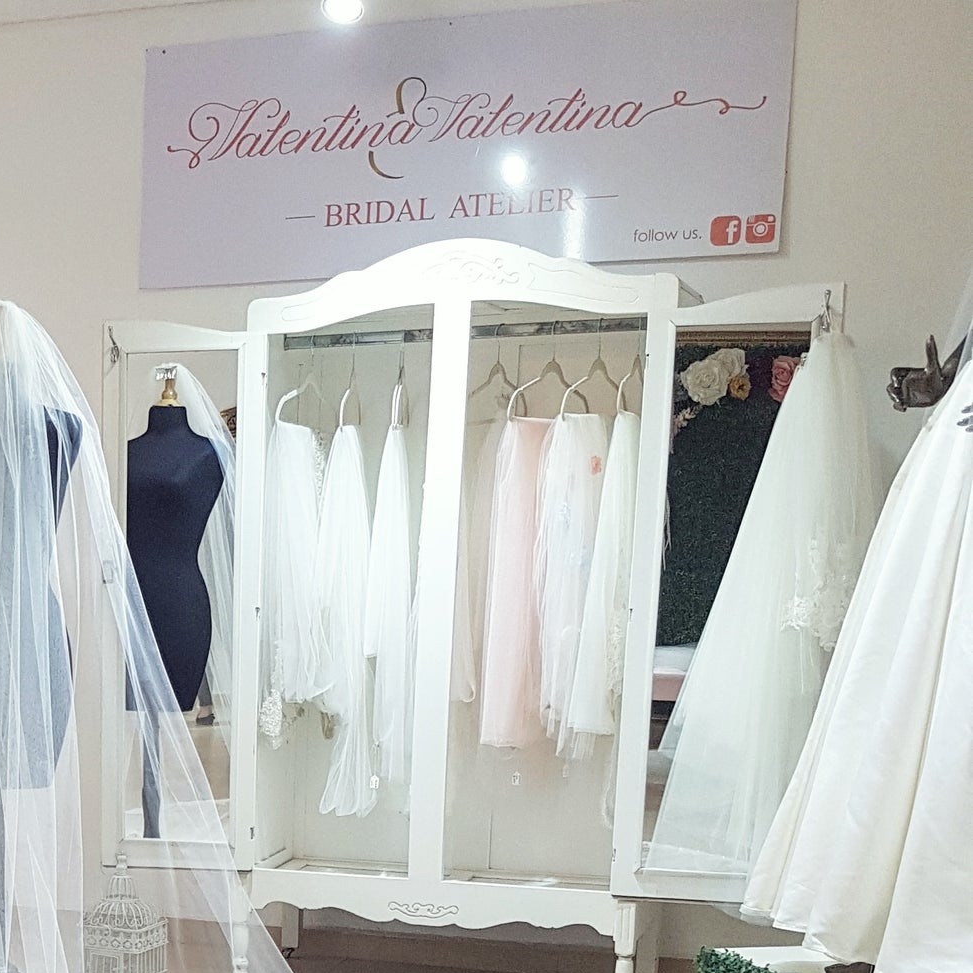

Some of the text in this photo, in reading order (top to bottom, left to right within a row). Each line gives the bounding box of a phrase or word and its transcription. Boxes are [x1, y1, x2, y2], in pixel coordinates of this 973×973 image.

[167, 86, 765, 169] Valentina Valentina
[323, 188, 578, 228] BRIDAL ATELIER
[633, 228, 703, 243] follow us.
